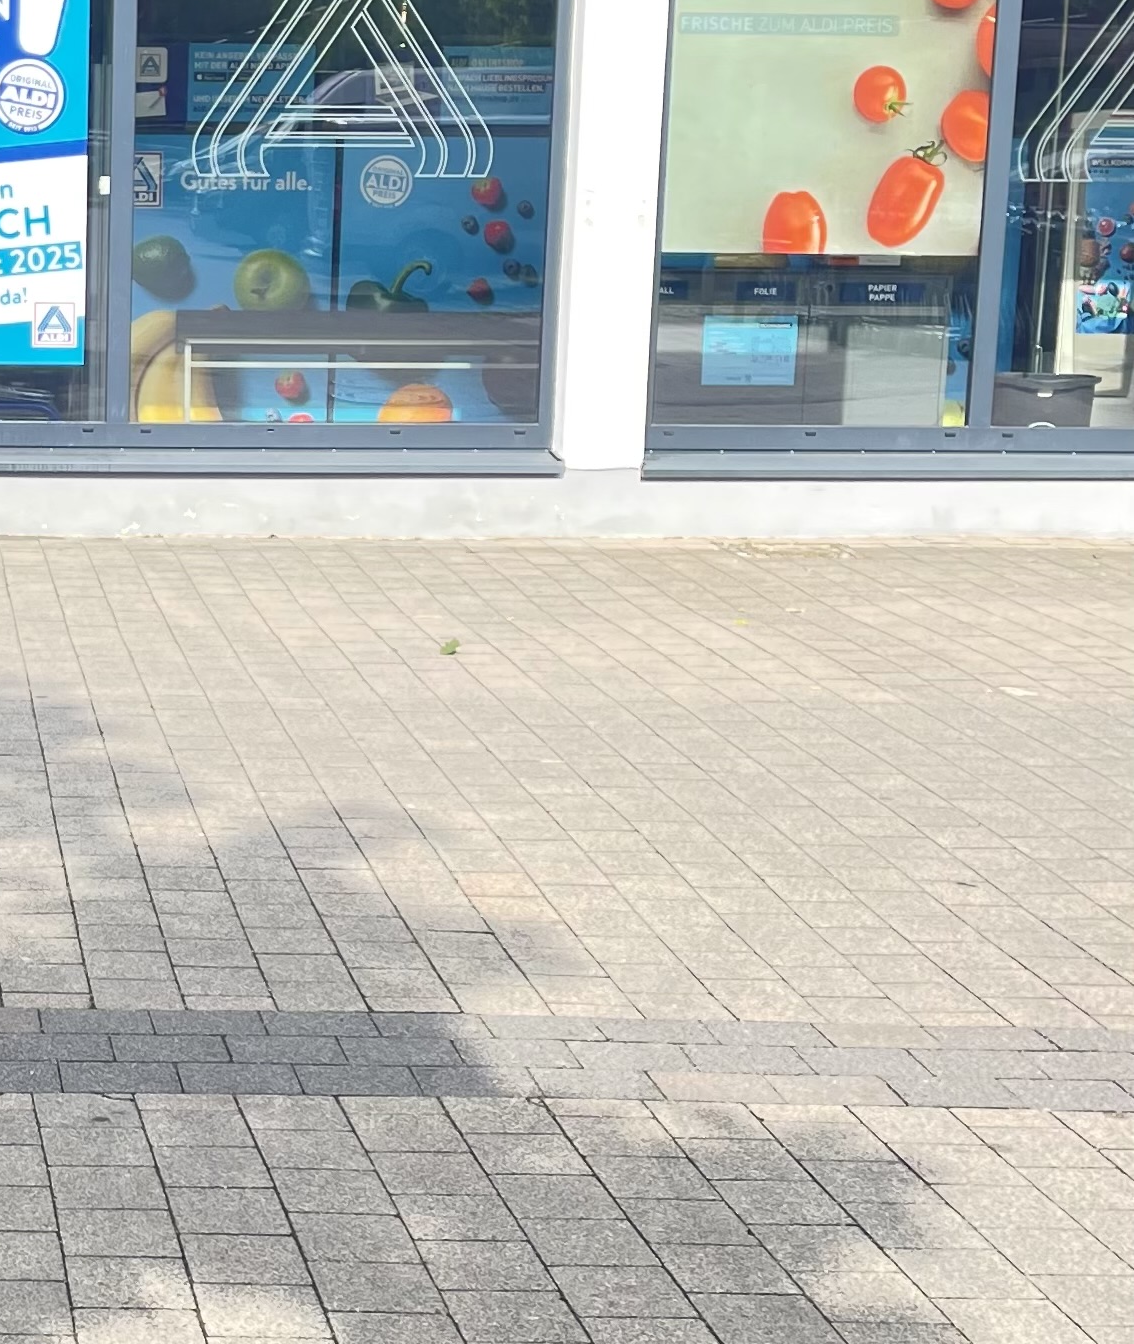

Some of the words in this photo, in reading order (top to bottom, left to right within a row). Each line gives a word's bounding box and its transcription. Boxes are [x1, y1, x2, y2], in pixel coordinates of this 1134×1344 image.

[681, 16, 754, 32] FRISCHE
[759, 17, 795, 32] ZUM
[800, 17, 837, 33] ALDI
[843, 17, 893, 33] PREIS
[11, 75, 52, 89] ORIGINAL
[0, 86, 56, 109] ALDI
[10, 105, 43, 120] PREIS
[180, 170, 239, 191] Gutes
[275, 171, 313, 191] alle.
[367, 174, 406, 192] ALDI
[10, 245, 81, 274] 2025
[0, 287, 28, 306] da!
[754, 287, 778, 296] FOLIE
[868, 284, 897, 293] PAPIER
[869, 293, 896, 302] PAPPE
